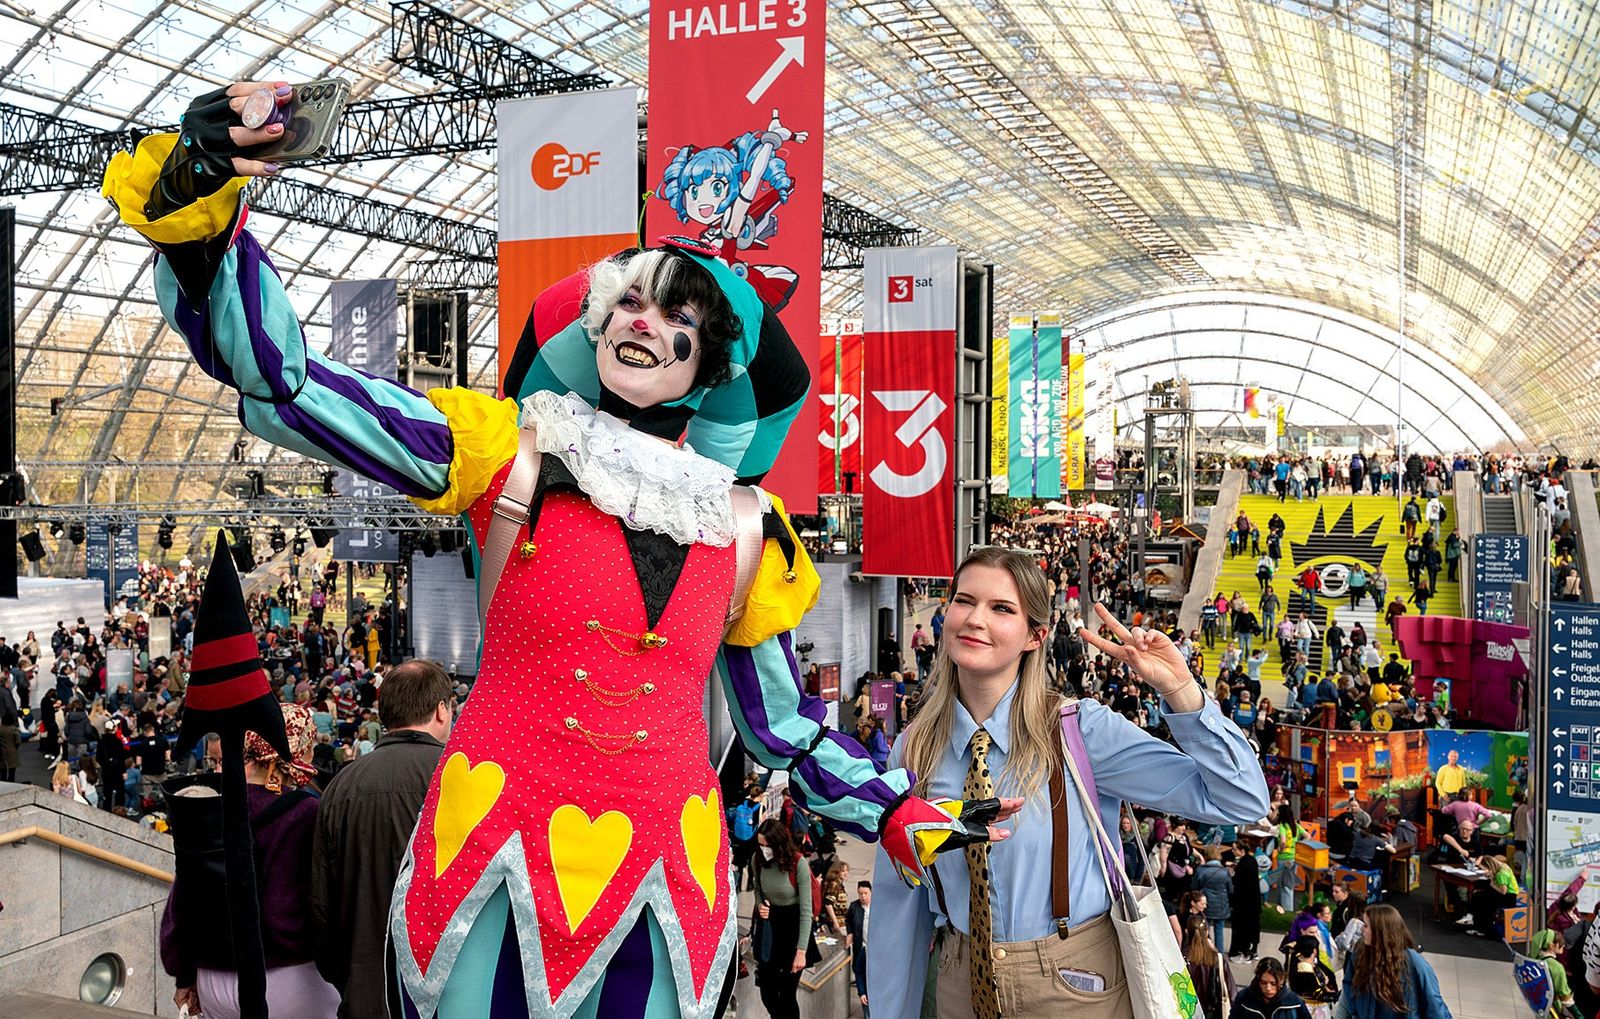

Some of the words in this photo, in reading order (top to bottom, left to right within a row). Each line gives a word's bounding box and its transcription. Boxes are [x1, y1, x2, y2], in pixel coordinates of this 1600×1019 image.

[668, 0, 778, 41] HALLE
[787, 0, 807, 28] 3
[552, 151, 602, 178] ZDF
[998, 405, 1006, 426] UND
[818, 394, 860, 450] 3
[1052, 419, 1061, 438] ARD
[868, 390, 947, 498] 3
[998, 428, 1006, 468] MENSCH
[1071, 441, 1079, 481] UKRAINE
[1504, 538, 1521, 550] 3,5
[1504, 550, 1520, 561] 2,4
[1571, 615, 1599, 625] Hallen
[1571, 626, 1593, 635] Halls
[1571, 639, 1599, 649] Hallen
[1571, 649, 1592, 659] Halls
[1570, 663, 1600, 675] Freigel
[1570, 687, 1600, 698] Eingan
[1571, 726, 1589, 735] EXIT
